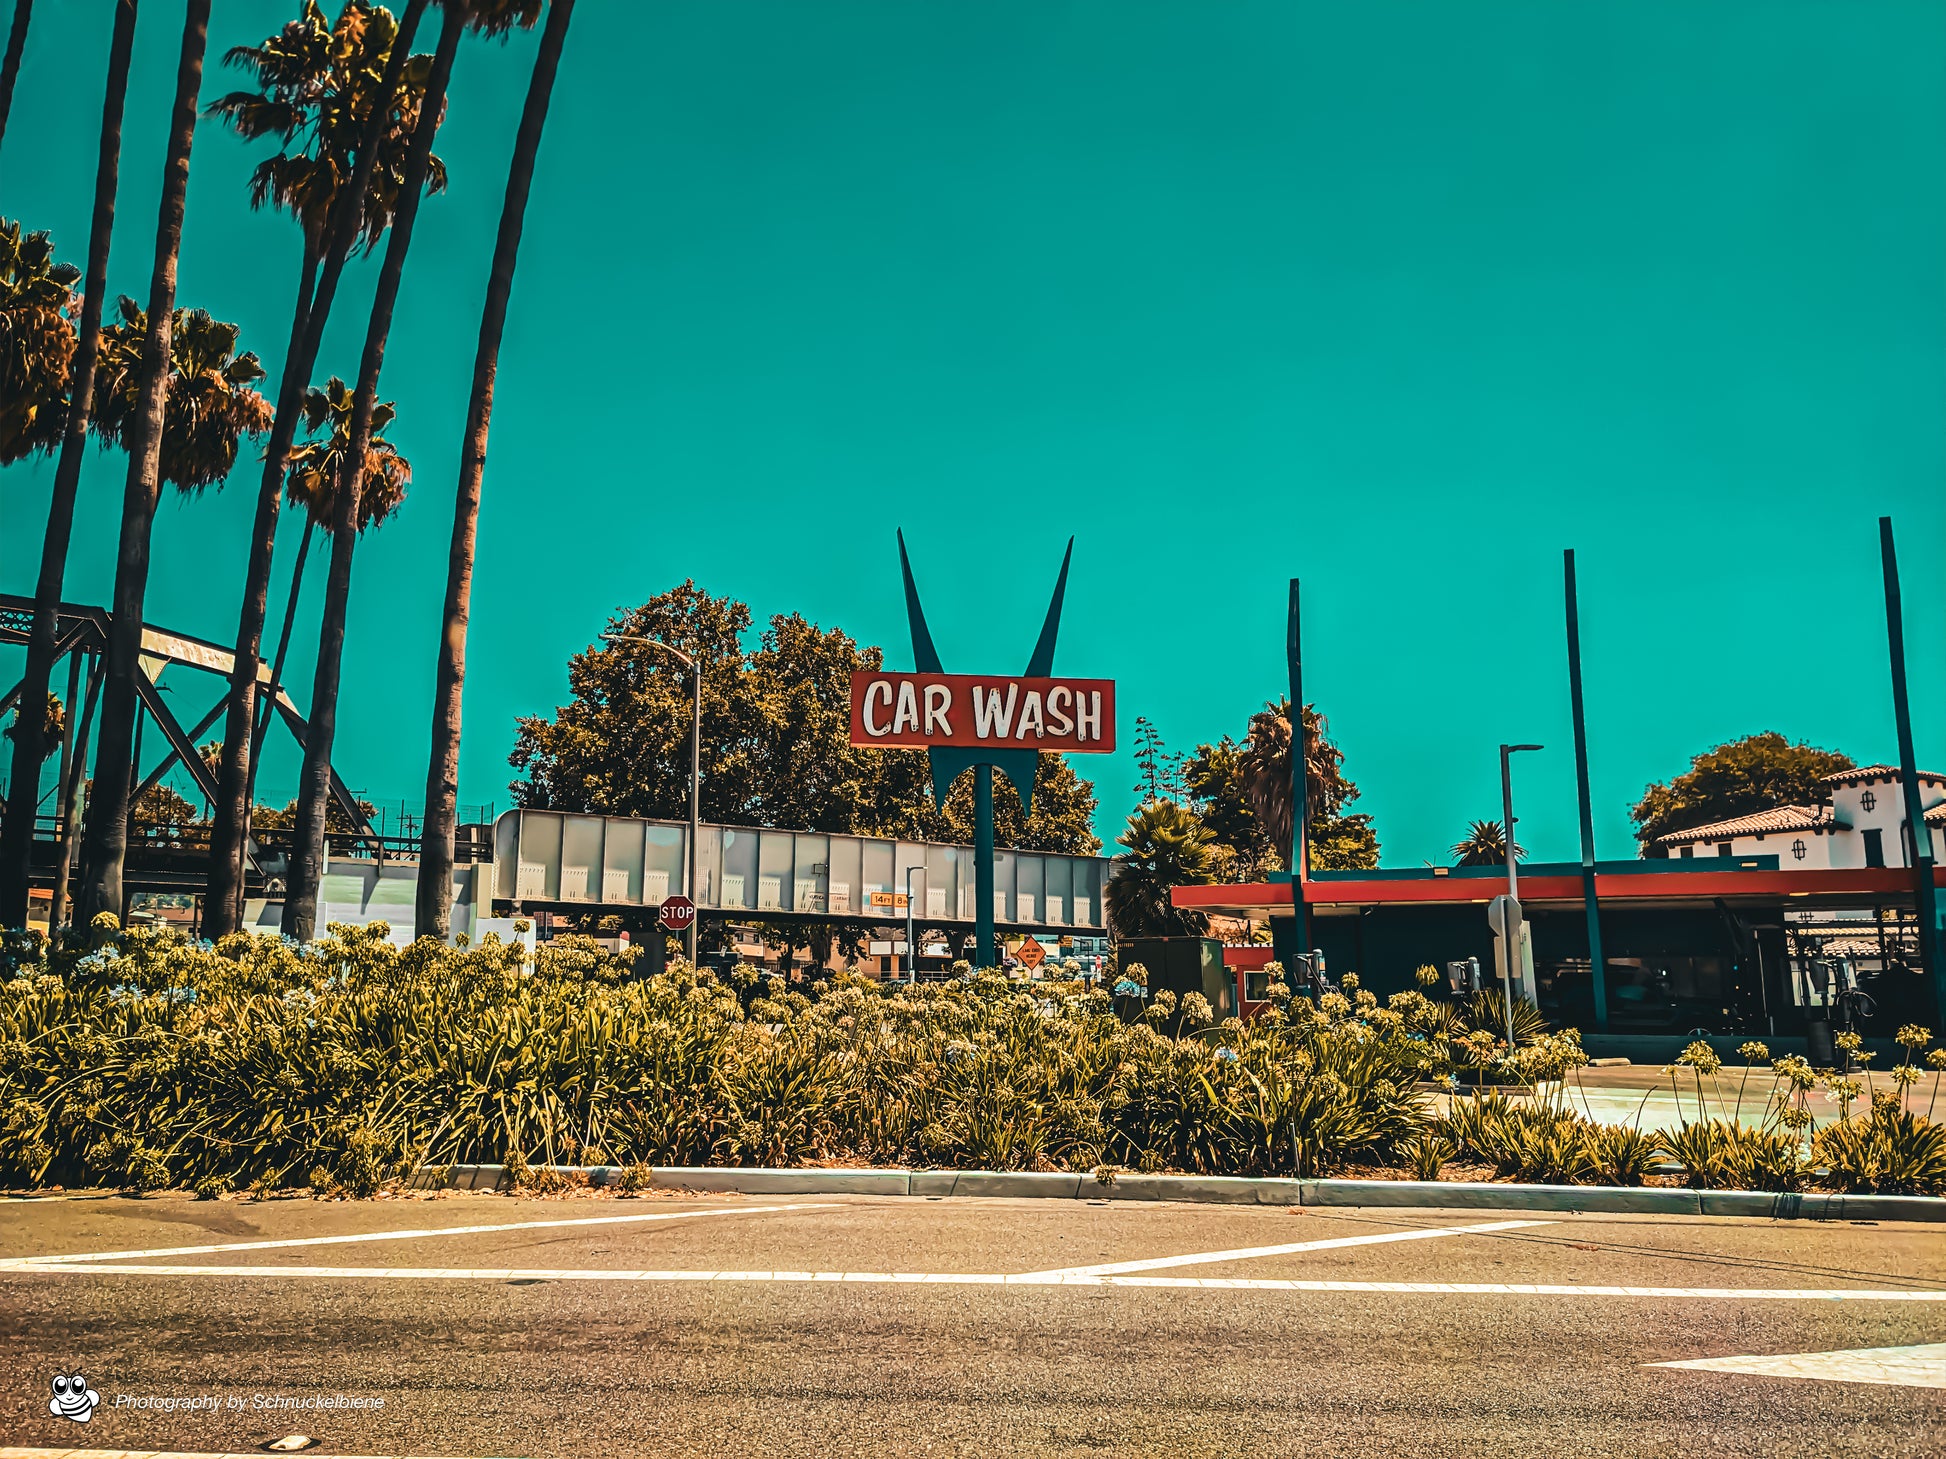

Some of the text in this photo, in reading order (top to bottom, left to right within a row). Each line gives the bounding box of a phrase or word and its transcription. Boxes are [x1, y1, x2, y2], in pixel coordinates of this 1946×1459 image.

[862, 679, 1101, 742] CAR WASH
[661, 906, 694, 919] STOP
